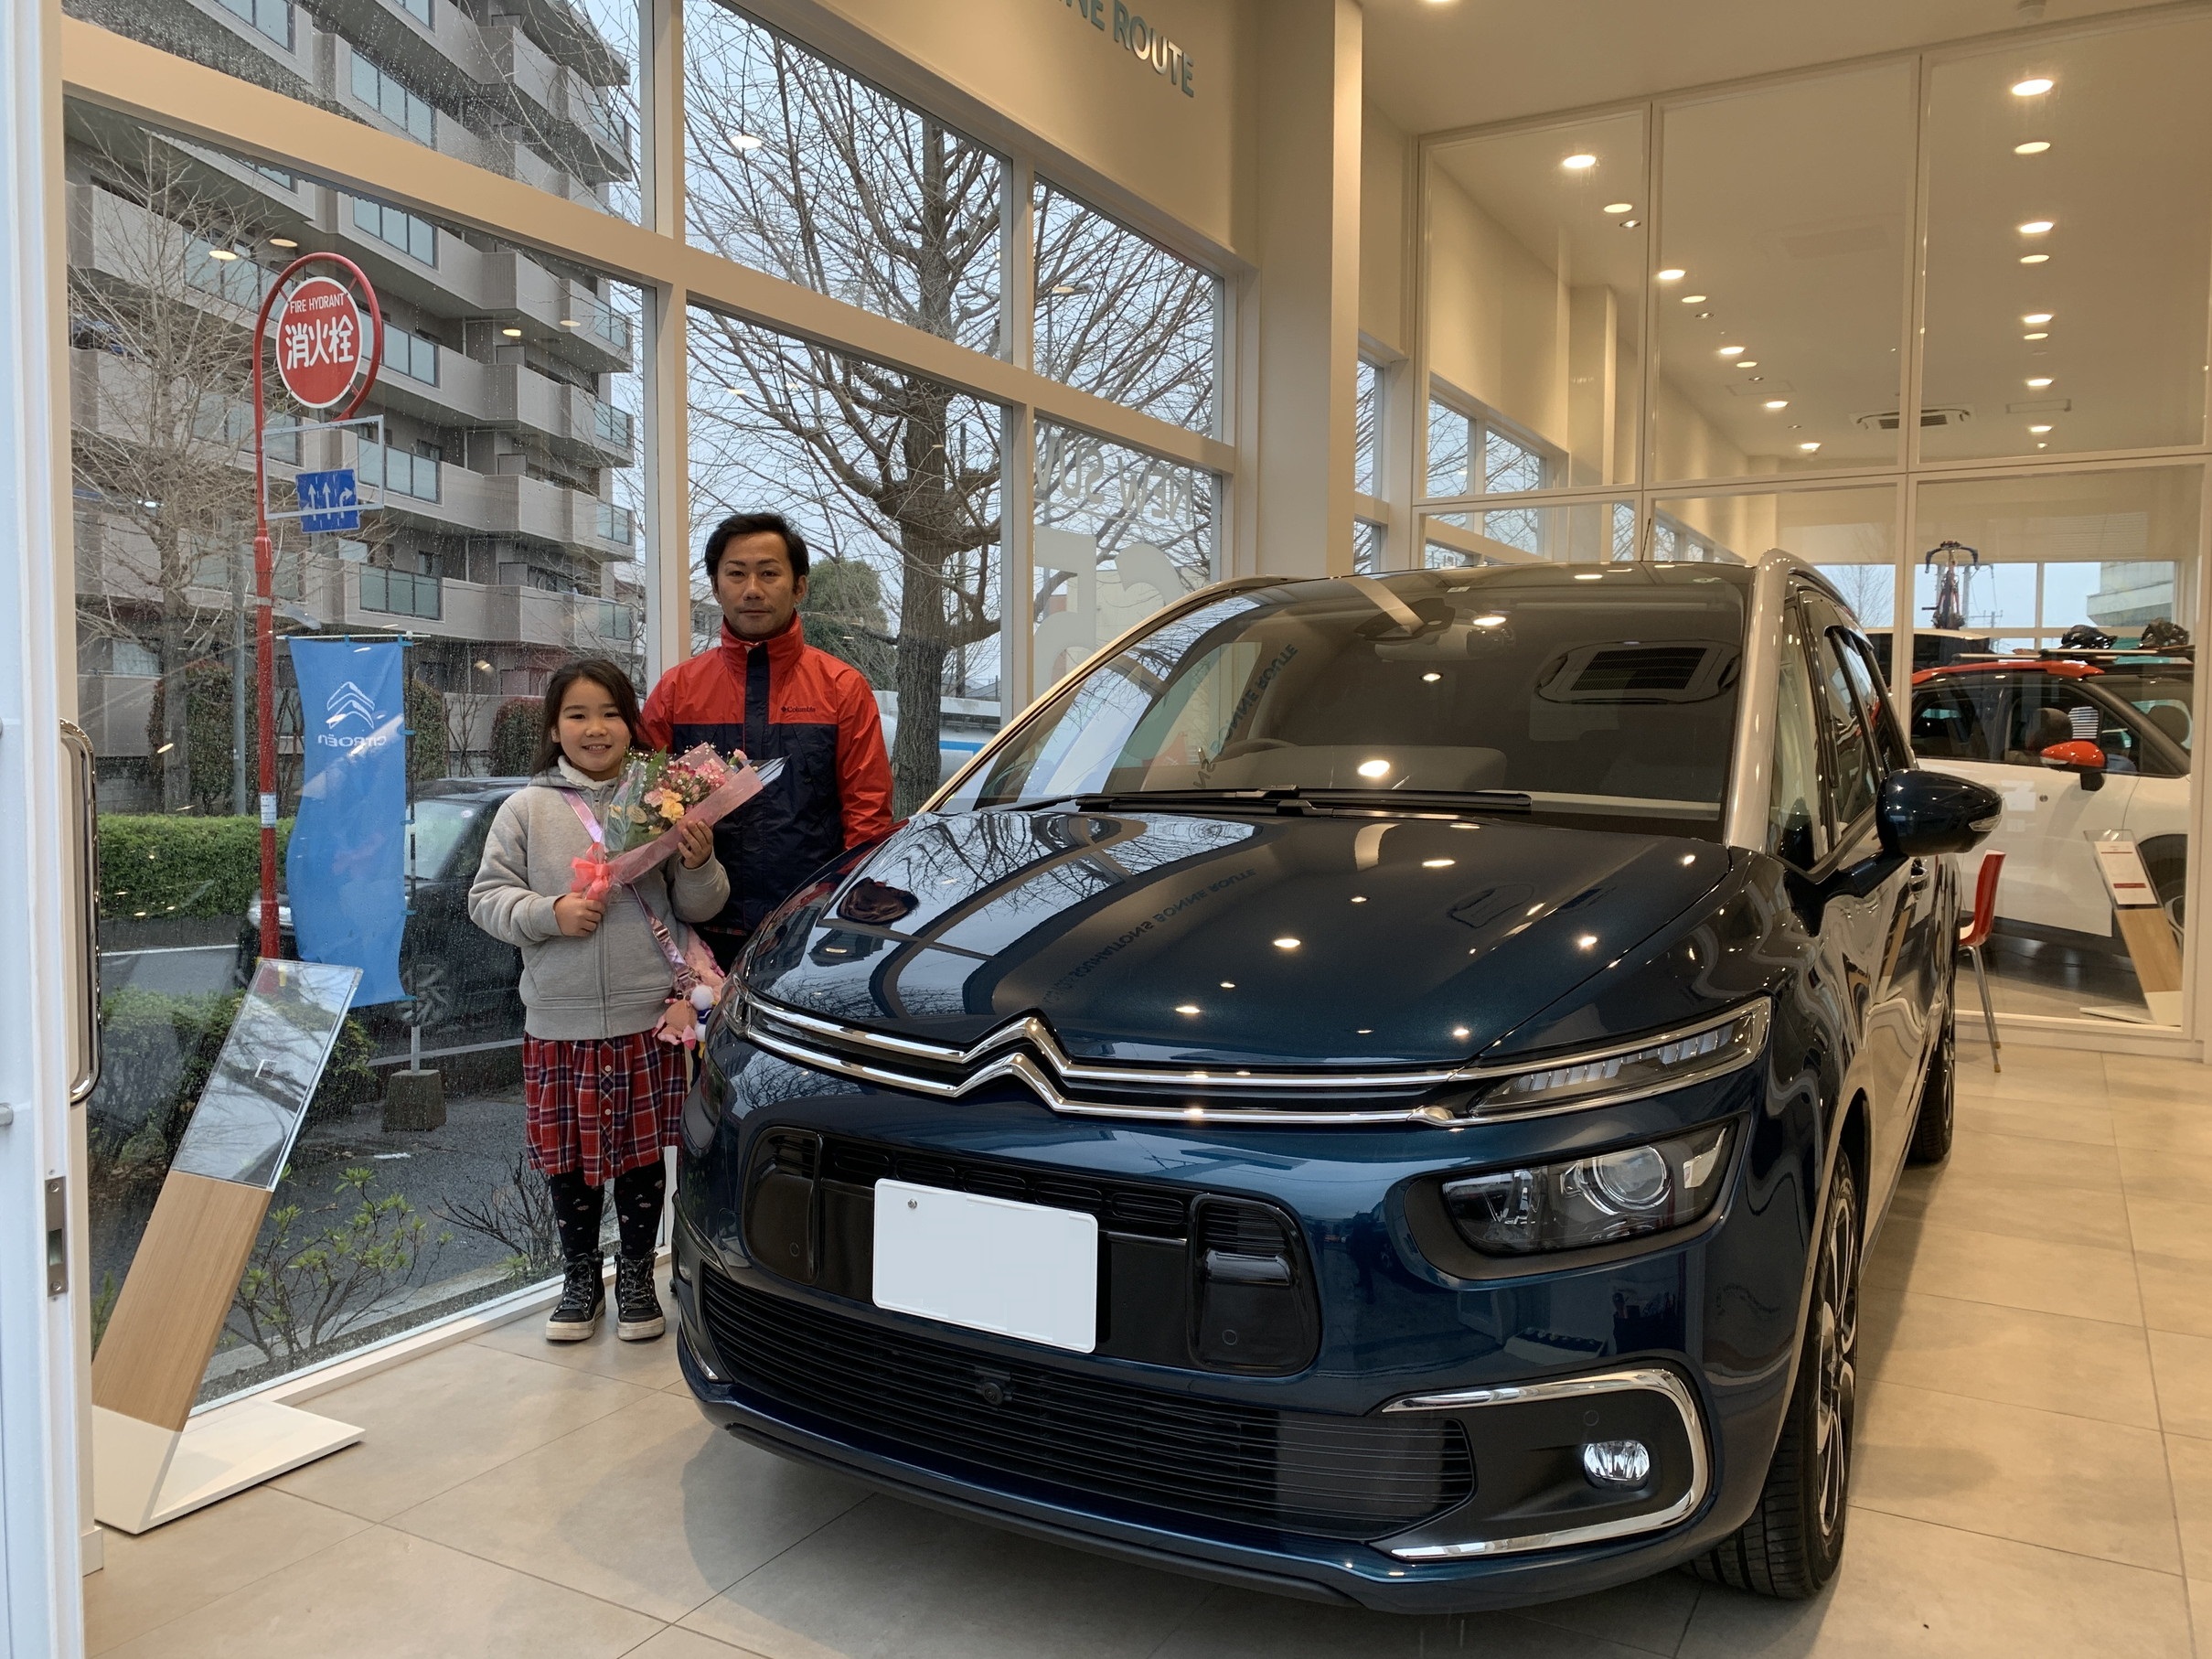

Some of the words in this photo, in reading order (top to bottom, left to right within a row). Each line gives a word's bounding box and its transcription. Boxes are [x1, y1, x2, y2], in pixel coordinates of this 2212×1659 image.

[1114, 0, 1194, 98] ROUTE
[290, 299, 307, 314] FIRE
[309, 294, 345, 311] HYDRANT
[284, 314, 355, 370] 消火栓
